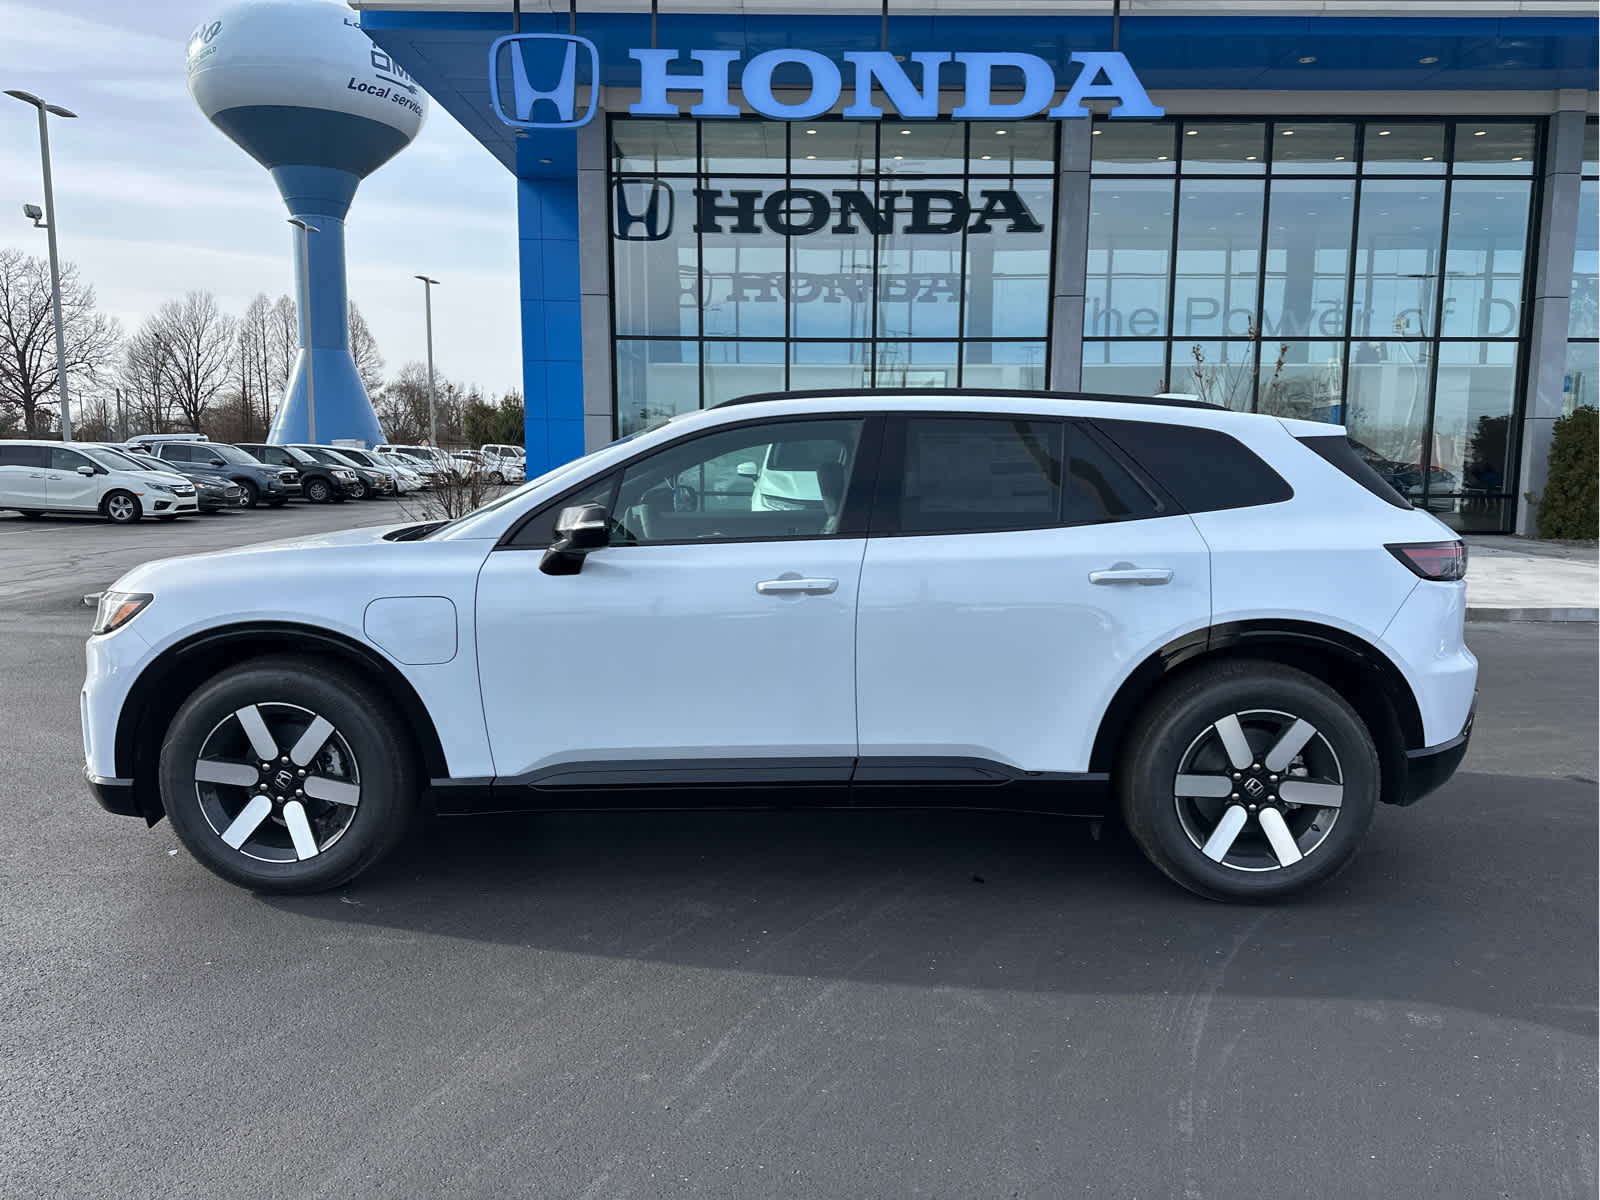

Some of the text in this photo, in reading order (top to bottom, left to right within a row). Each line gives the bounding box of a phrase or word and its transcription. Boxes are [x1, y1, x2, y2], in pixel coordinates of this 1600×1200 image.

[347, 77, 423, 118] Local service
[628, 48, 1166, 120] HONDA
[692, 188, 1045, 236] HONDA
[1086, 297, 1160, 336] he
[1185, 297, 1374, 337] Power
